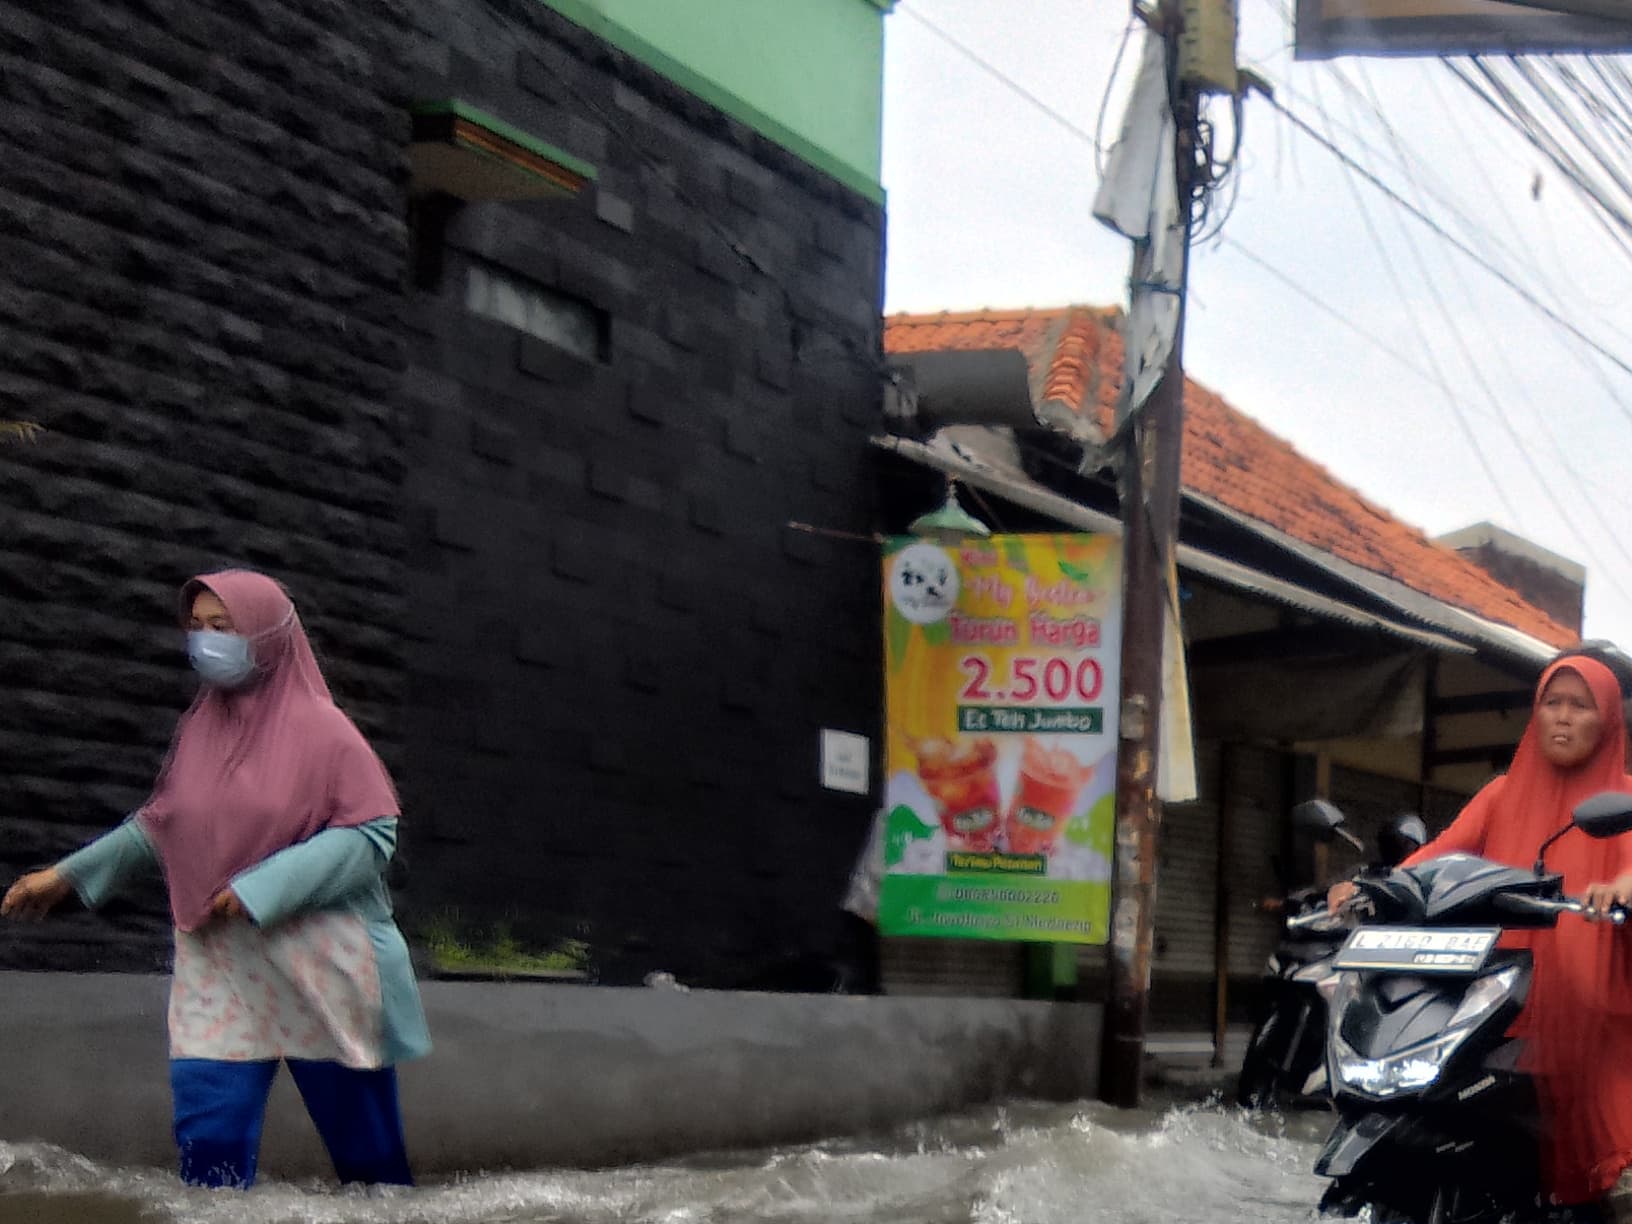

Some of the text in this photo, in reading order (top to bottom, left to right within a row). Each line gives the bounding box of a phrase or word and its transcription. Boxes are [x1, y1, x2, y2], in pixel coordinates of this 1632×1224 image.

[949, 609, 1100, 647] Turun Harga
[961, 656, 1104, 703] 2.500
